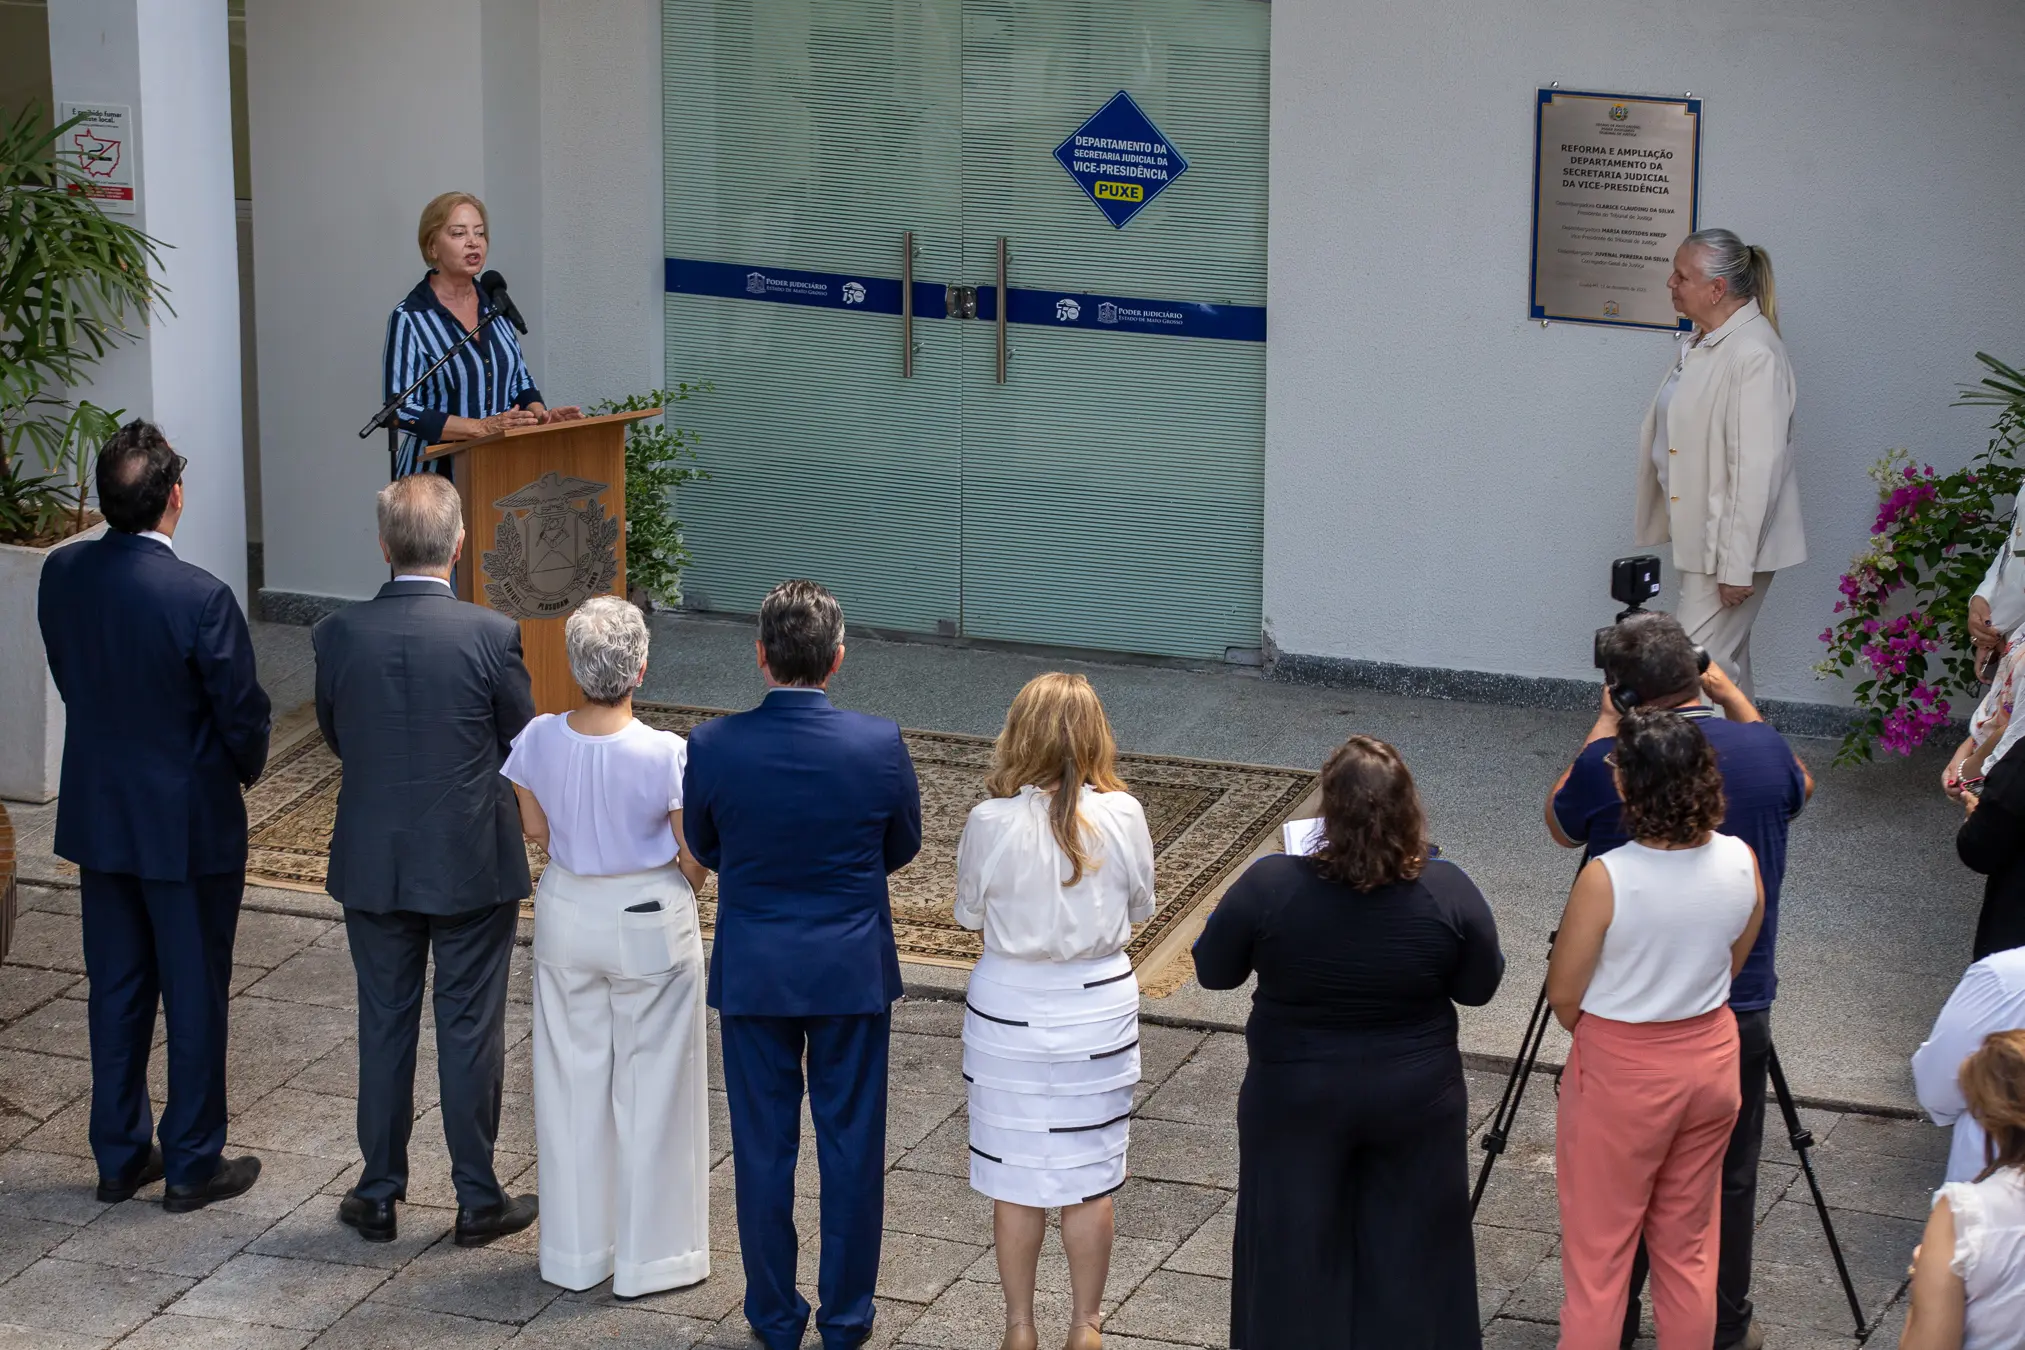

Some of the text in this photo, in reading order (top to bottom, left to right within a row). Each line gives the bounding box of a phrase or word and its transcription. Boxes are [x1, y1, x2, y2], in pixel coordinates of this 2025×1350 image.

[1075, 136, 1167, 154] DEPARTAMENTO DA
[1561, 144, 1607, 155] REFORMA
[1617, 148, 1673, 160] AMPLIAÇÃO
[1074, 149, 1168, 166] SECRETARIA JUDICIAL DA
[1570, 156, 1663, 170] DEPARTAMENTO DA
[1073, 161, 1168, 180] VICE-PRESIDÊNCIA
[1563, 168, 1669, 182] SECRETARIA JUDICIAL
[1098, 184, 1139, 199] PUXE
[1562, 180, 1669, 194] DA VICE-PRESIDÊNCIA
[1595, 203, 1619, 211] CLARICE
[766, 278, 827, 291] PODER JUDICIÁRIO
[1118, 307, 1183, 319] PODER JUDICIÁRIO
